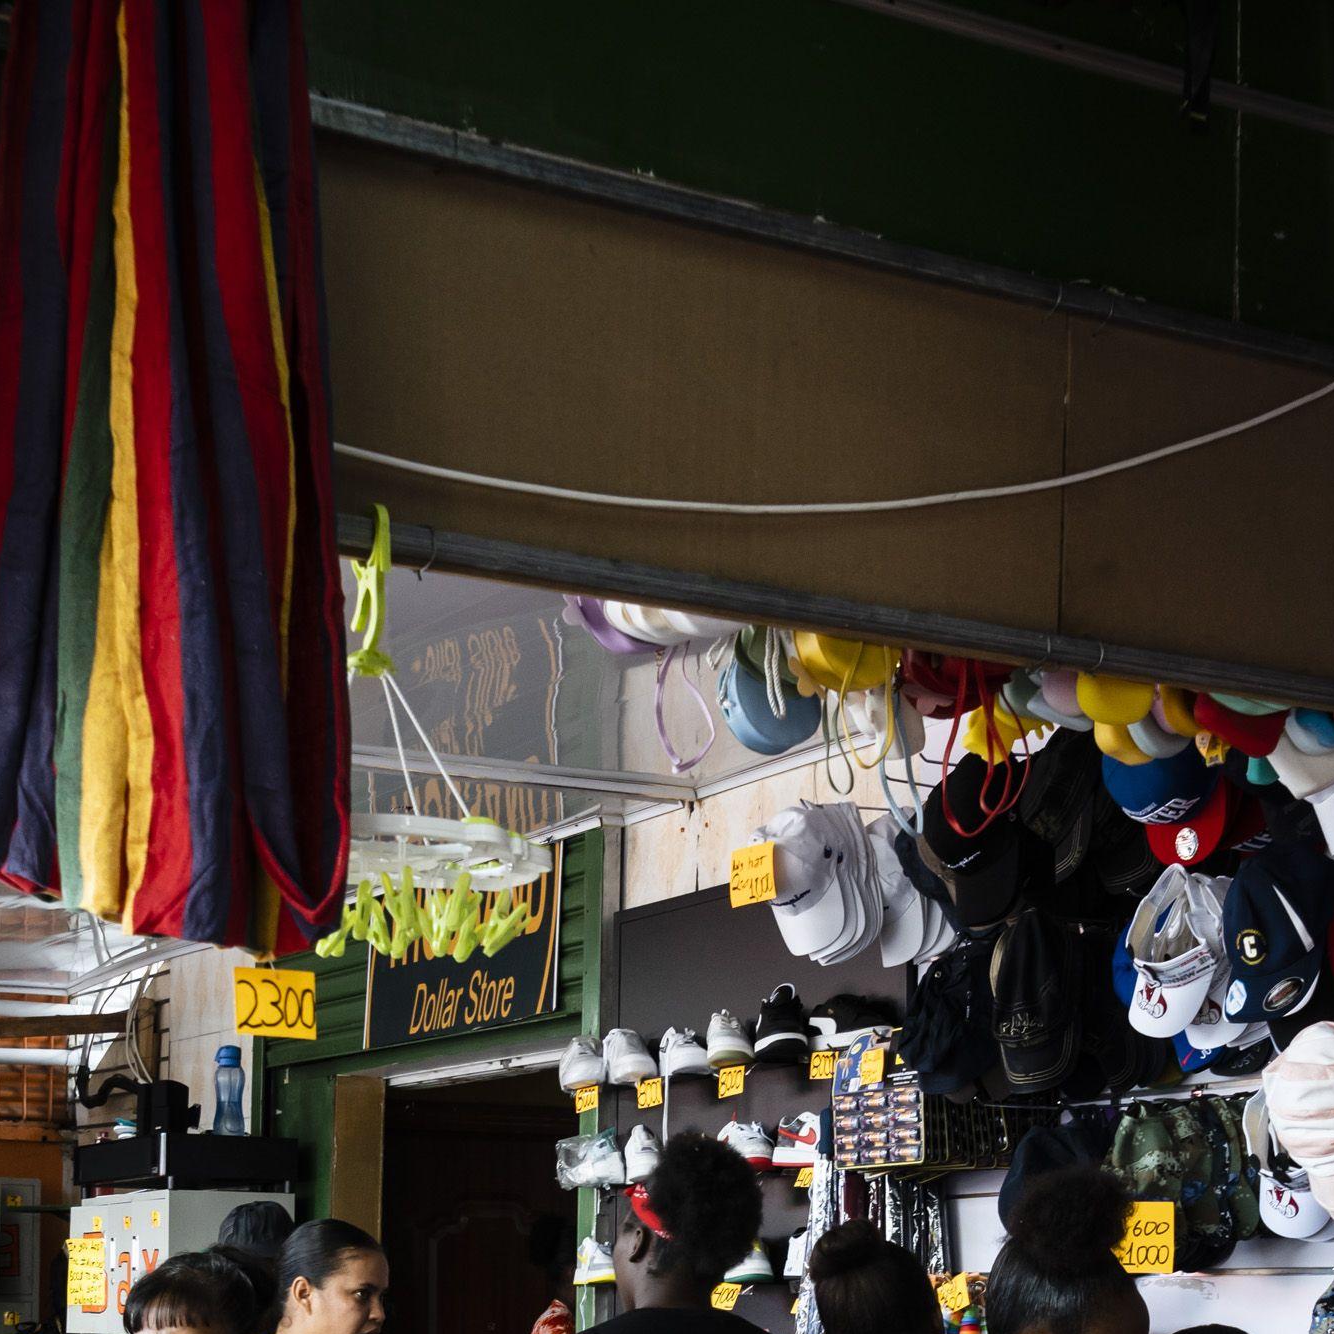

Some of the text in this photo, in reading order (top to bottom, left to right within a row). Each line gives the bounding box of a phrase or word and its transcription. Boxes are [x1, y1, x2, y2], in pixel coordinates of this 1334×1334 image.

[236, 979, 316, 1030] 2300
[409, 969, 515, 1035] Dollar Store
[797, 1171, 813, 1186] 40
[1133, 1221, 1171, 1237] 600
[1123, 1242, 1170, 1266] 1000
